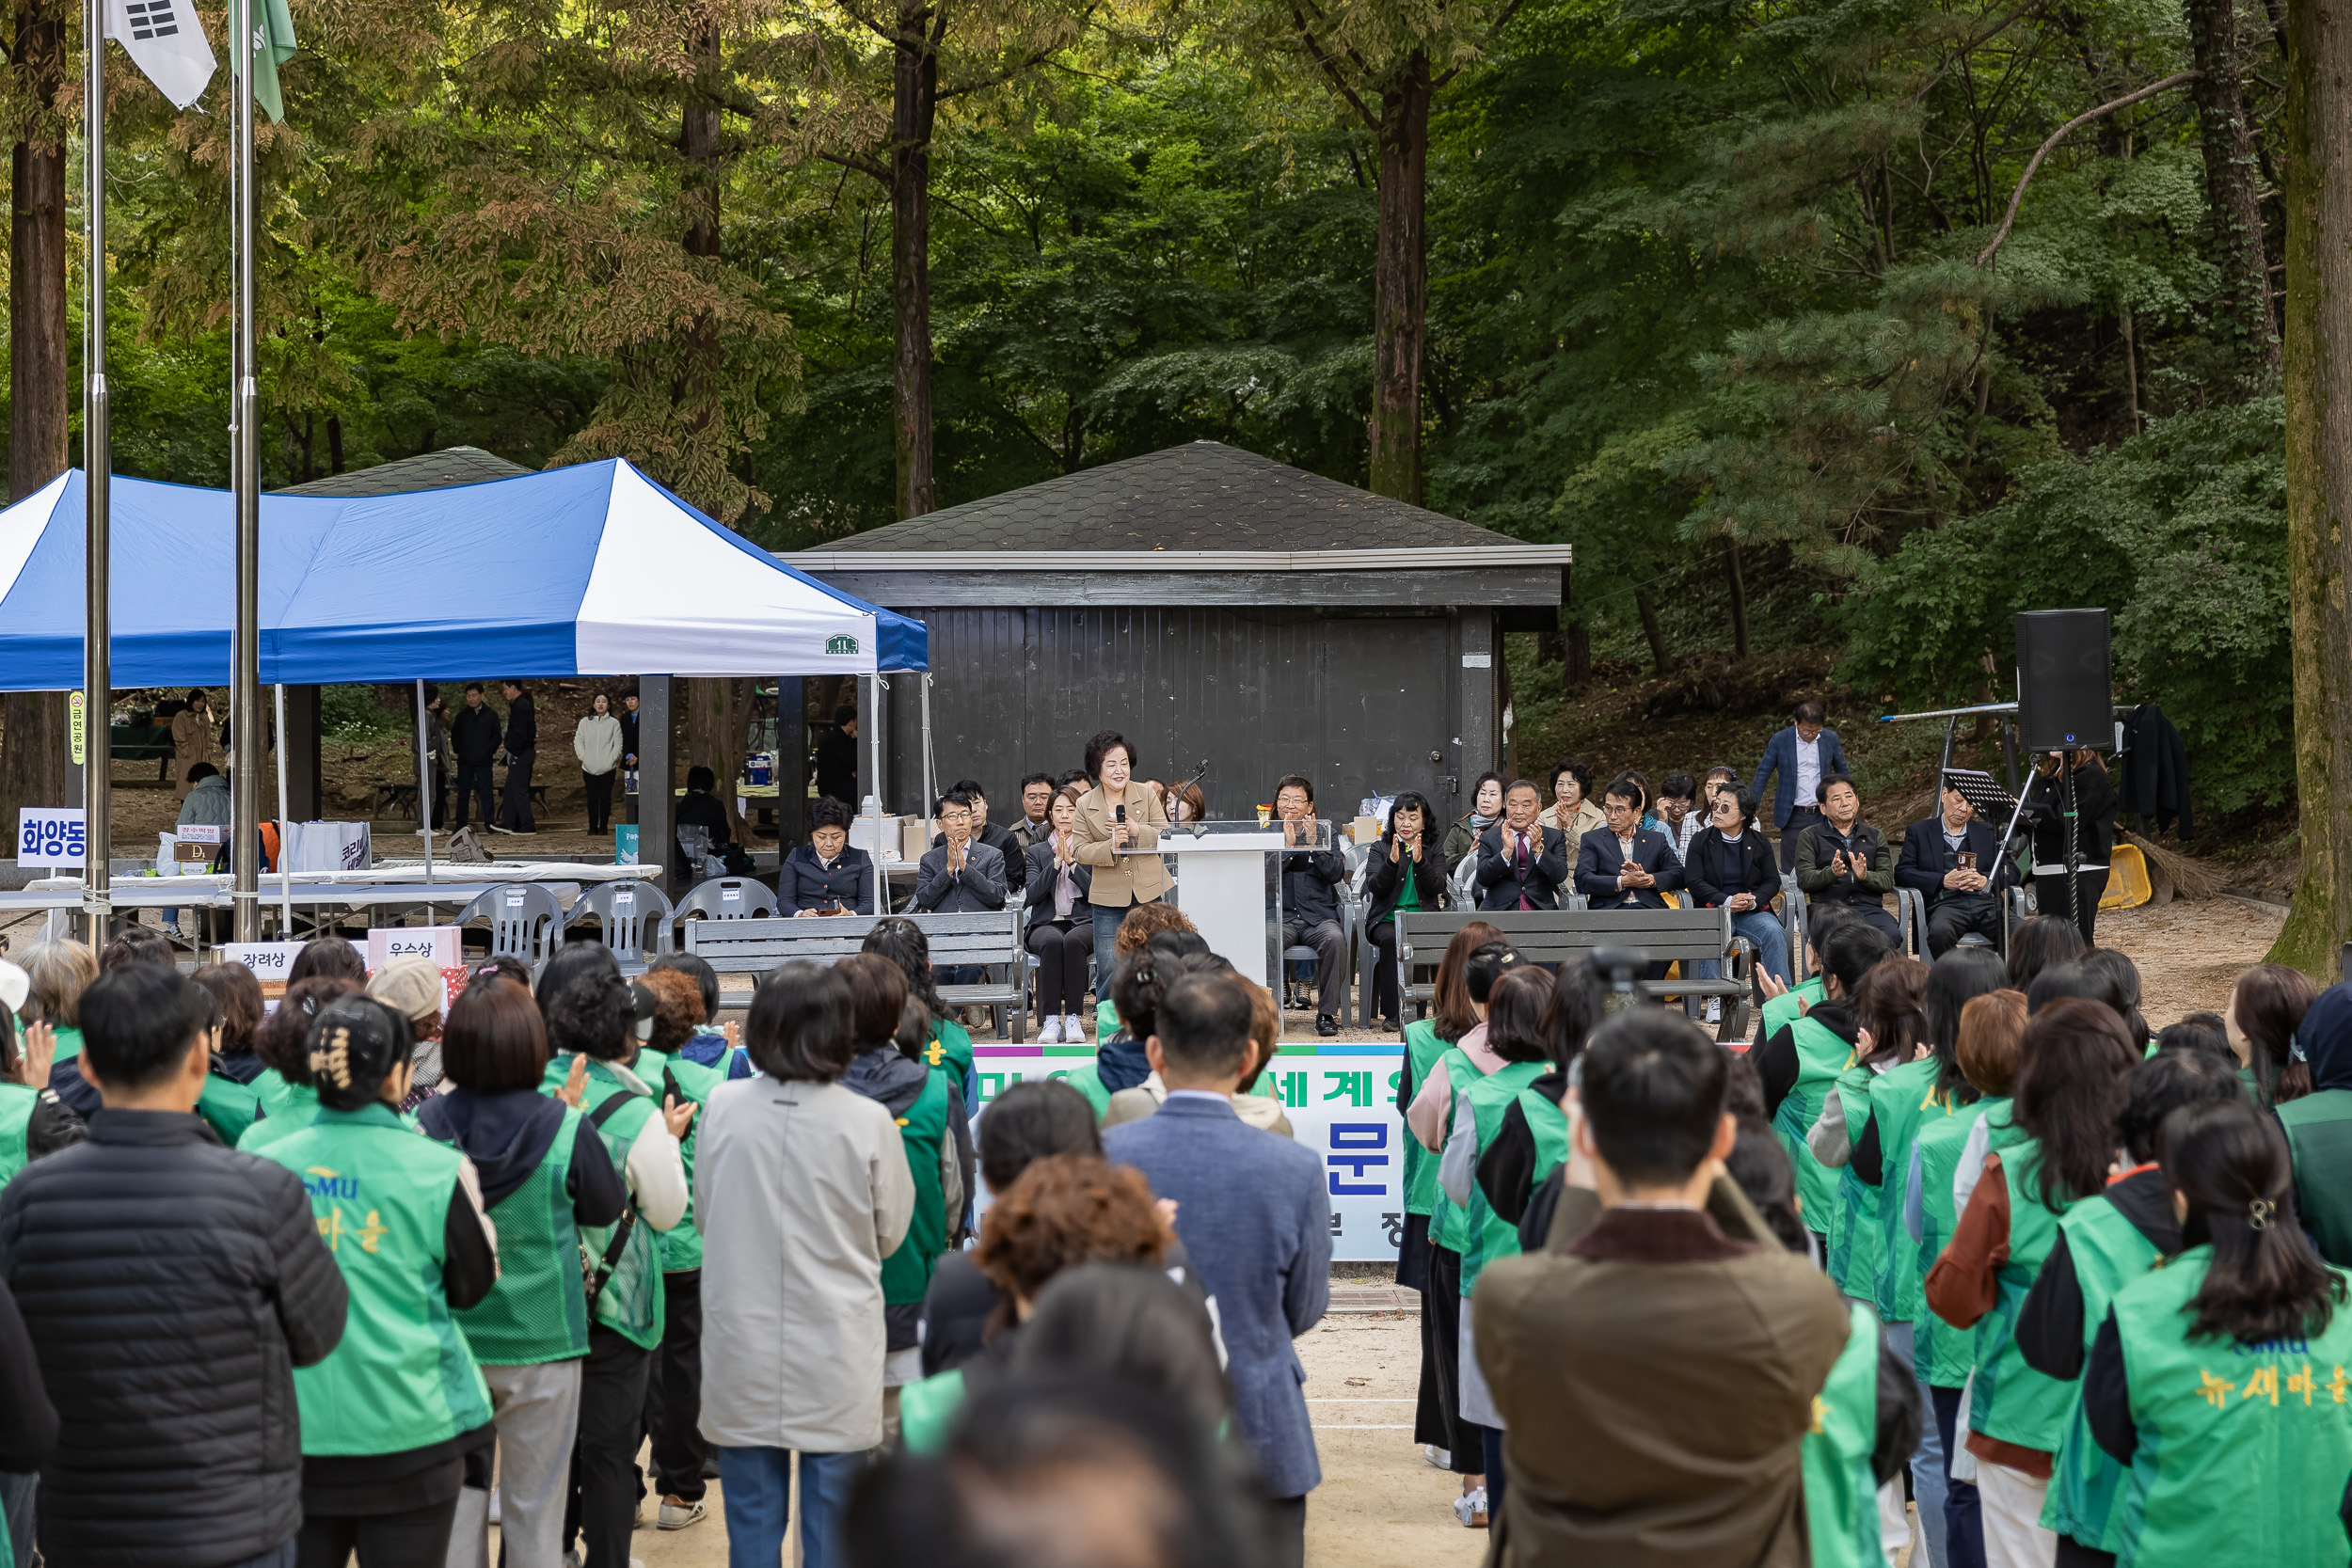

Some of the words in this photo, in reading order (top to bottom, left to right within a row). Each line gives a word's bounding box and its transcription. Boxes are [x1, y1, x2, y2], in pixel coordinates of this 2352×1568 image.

[72, 708, 83, 754] 금연공원
[22, 819, 86, 857] 화양동
[243, 952, 286, 969] 장려상
[1327, 1122, 1390, 1196] 문
